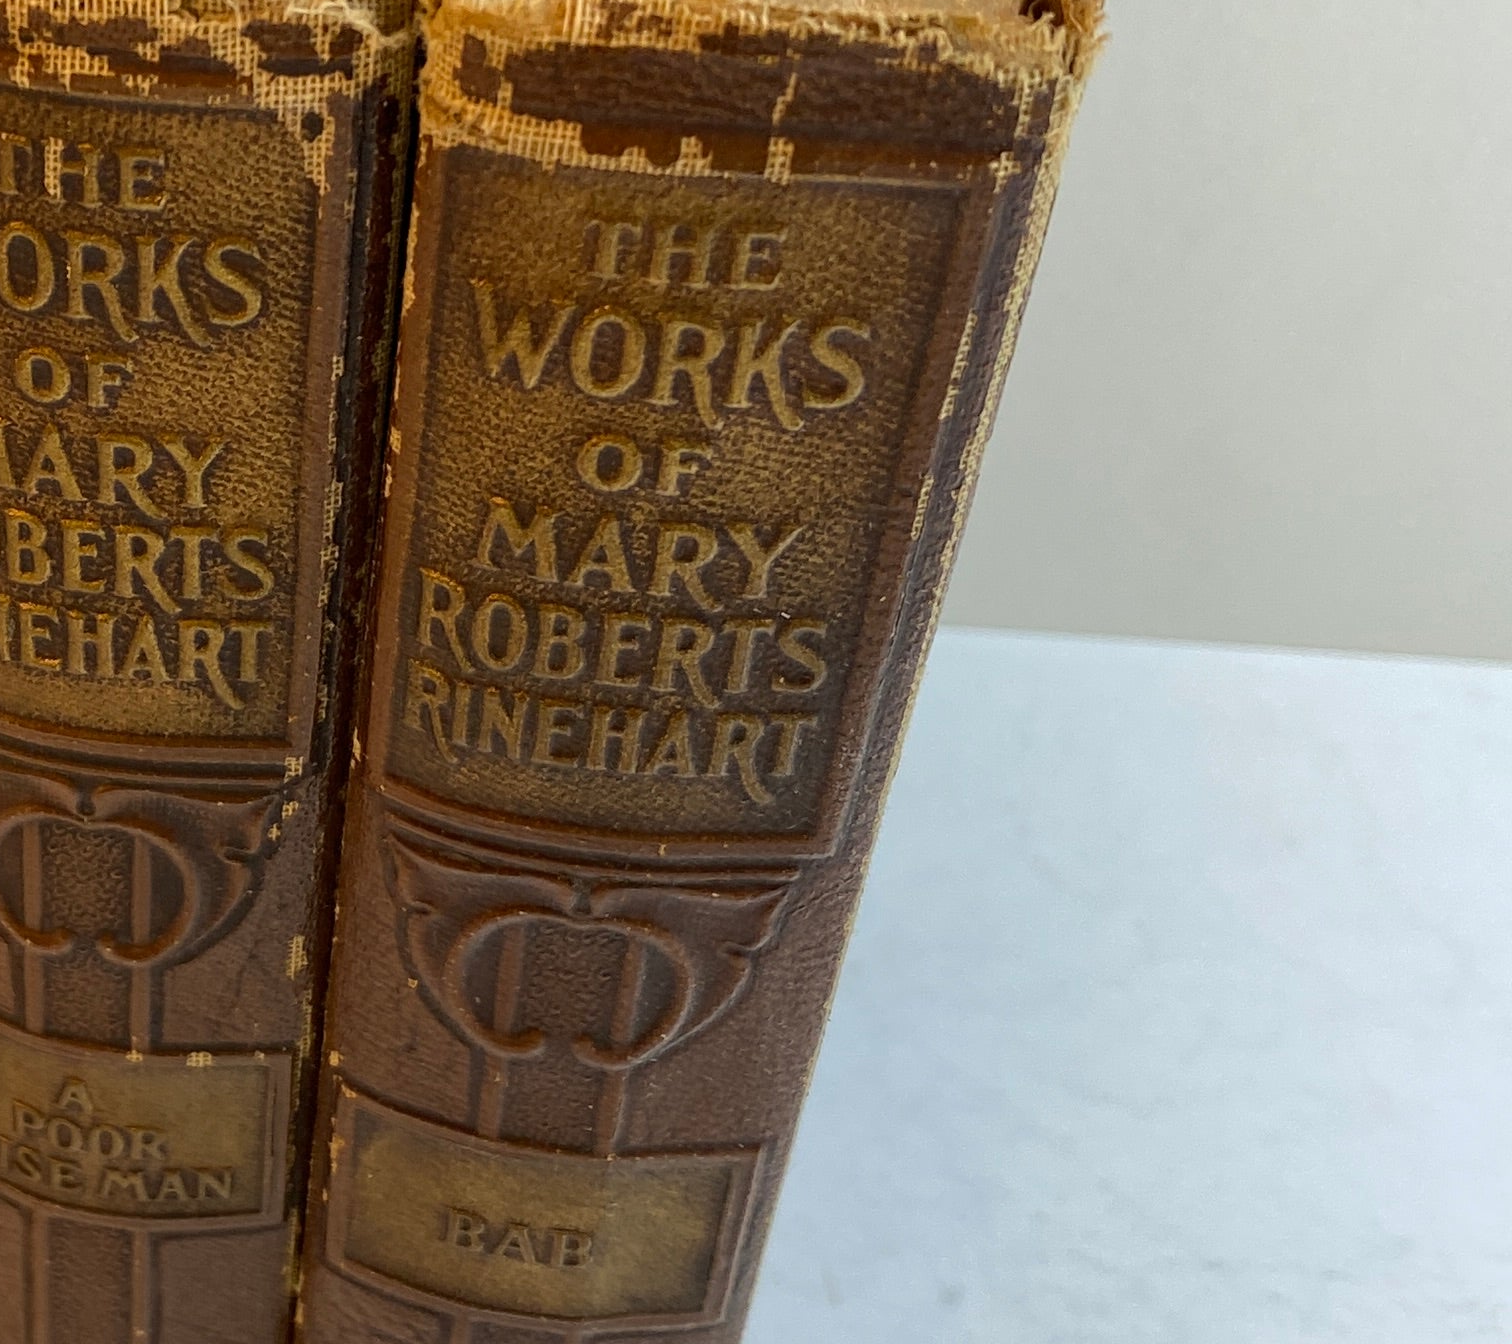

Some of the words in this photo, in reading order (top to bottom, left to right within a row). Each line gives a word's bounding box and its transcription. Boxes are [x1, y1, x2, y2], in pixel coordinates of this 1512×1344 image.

[588, 217, 786, 292] THE
[13, 346, 133, 410] OF
[469, 279, 873, 432] WORKS
[576, 434, 713, 497] OF
[475, 496, 809, 614] MARY
[418, 567, 829, 711] ROBERTS
[402, 656, 819, 806] RINEHART
[53, 1076, 94, 1117] A
[12, 1100, 168, 1161] POOR
[98, 1166, 235, 1203] MAN
[442, 1205, 594, 1269] BAB
